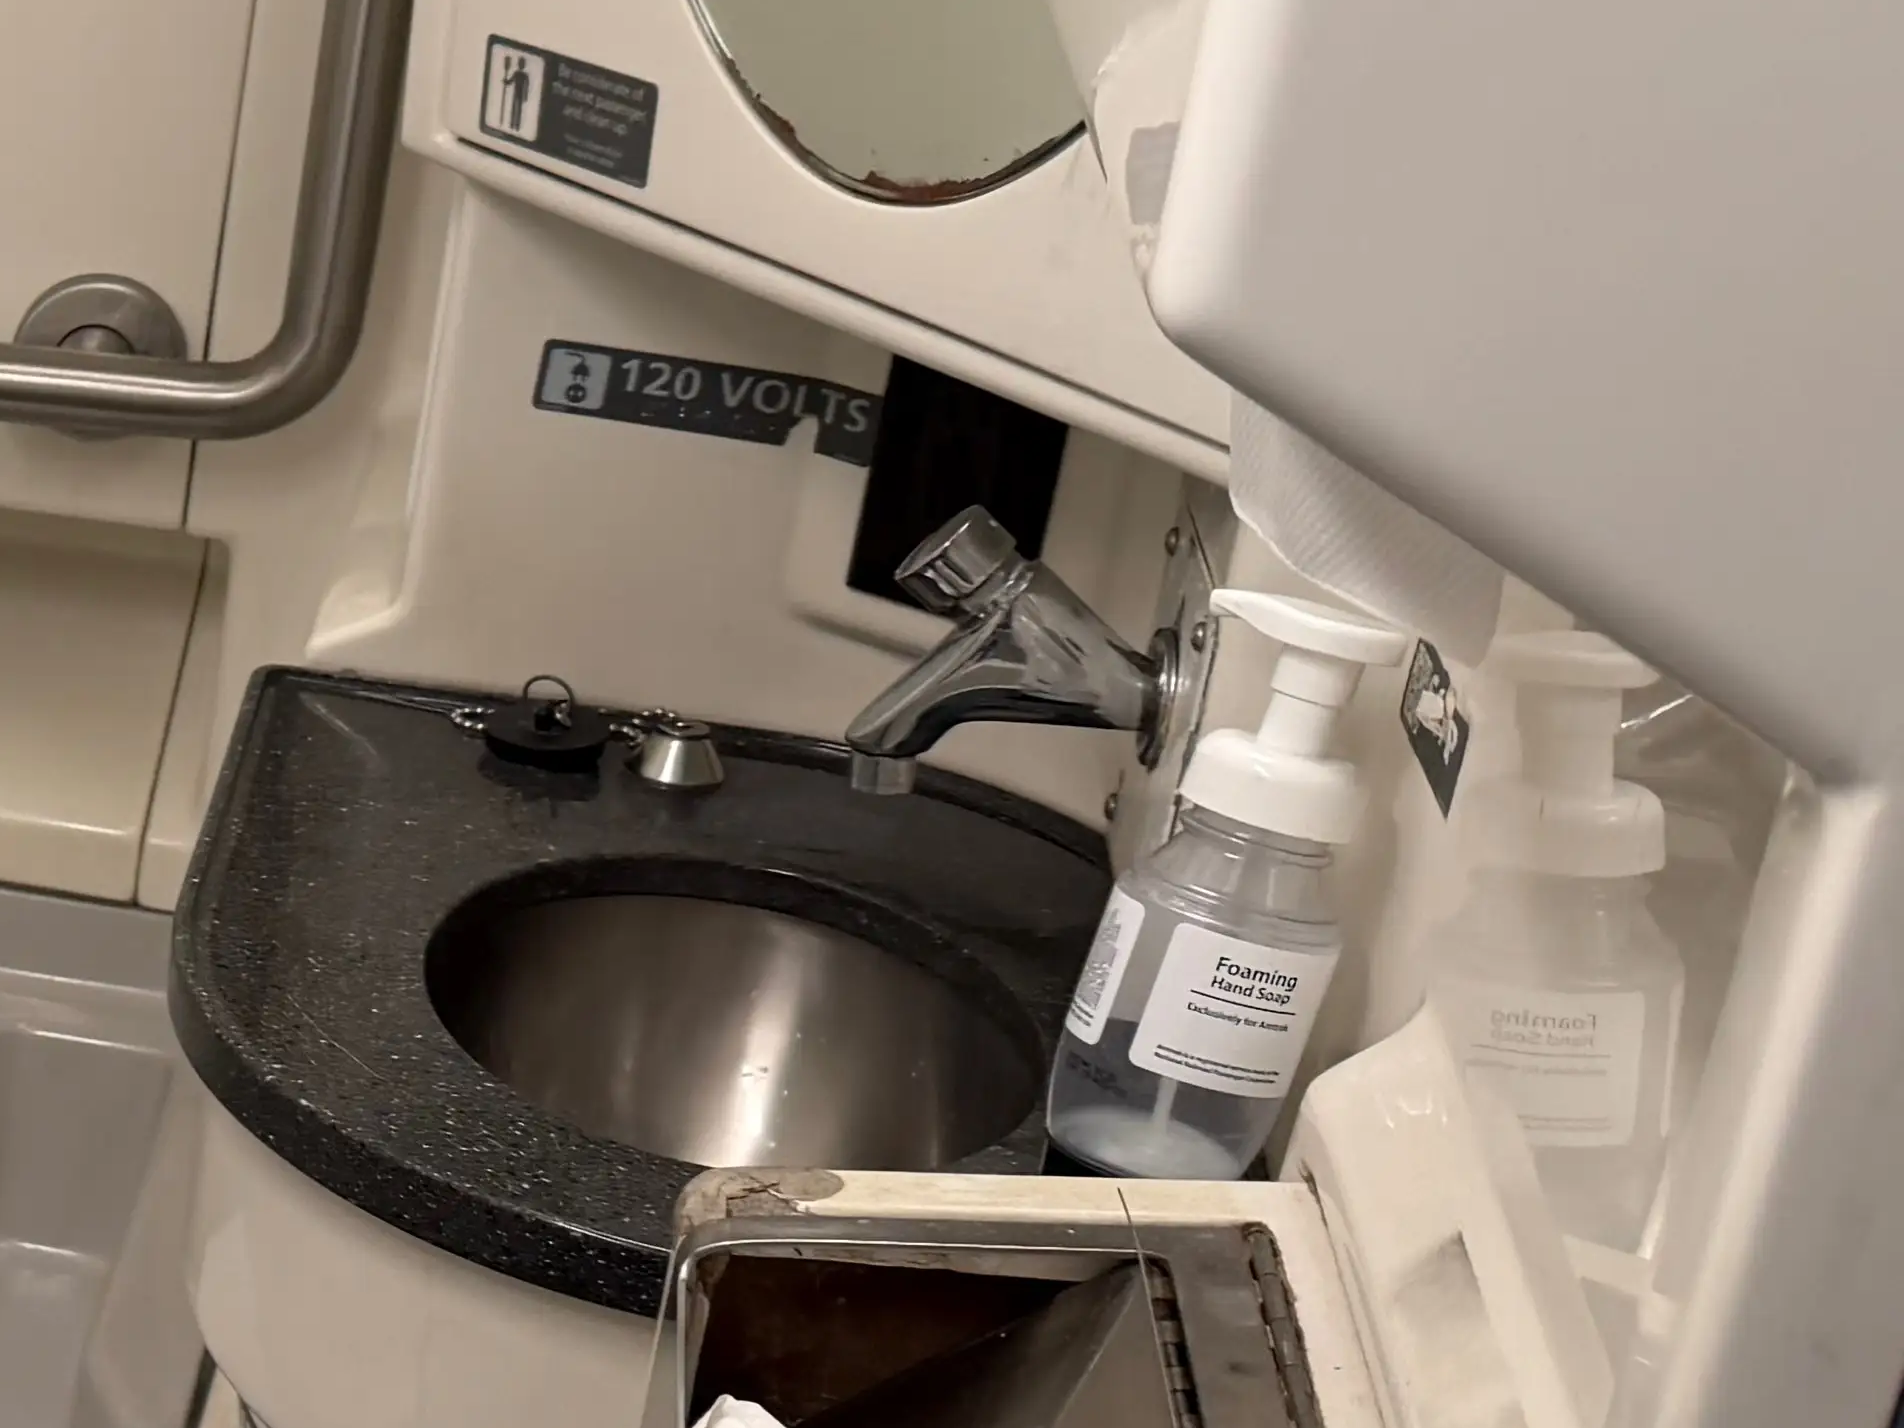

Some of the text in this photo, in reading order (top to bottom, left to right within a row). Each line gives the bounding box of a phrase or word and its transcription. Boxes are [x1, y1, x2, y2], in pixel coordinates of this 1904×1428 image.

[621, 359, 871, 433] 120 VOLTS
[1211, 975, 1291, 1007] Hand Soap
[1216, 956, 1298, 992] Foaming
